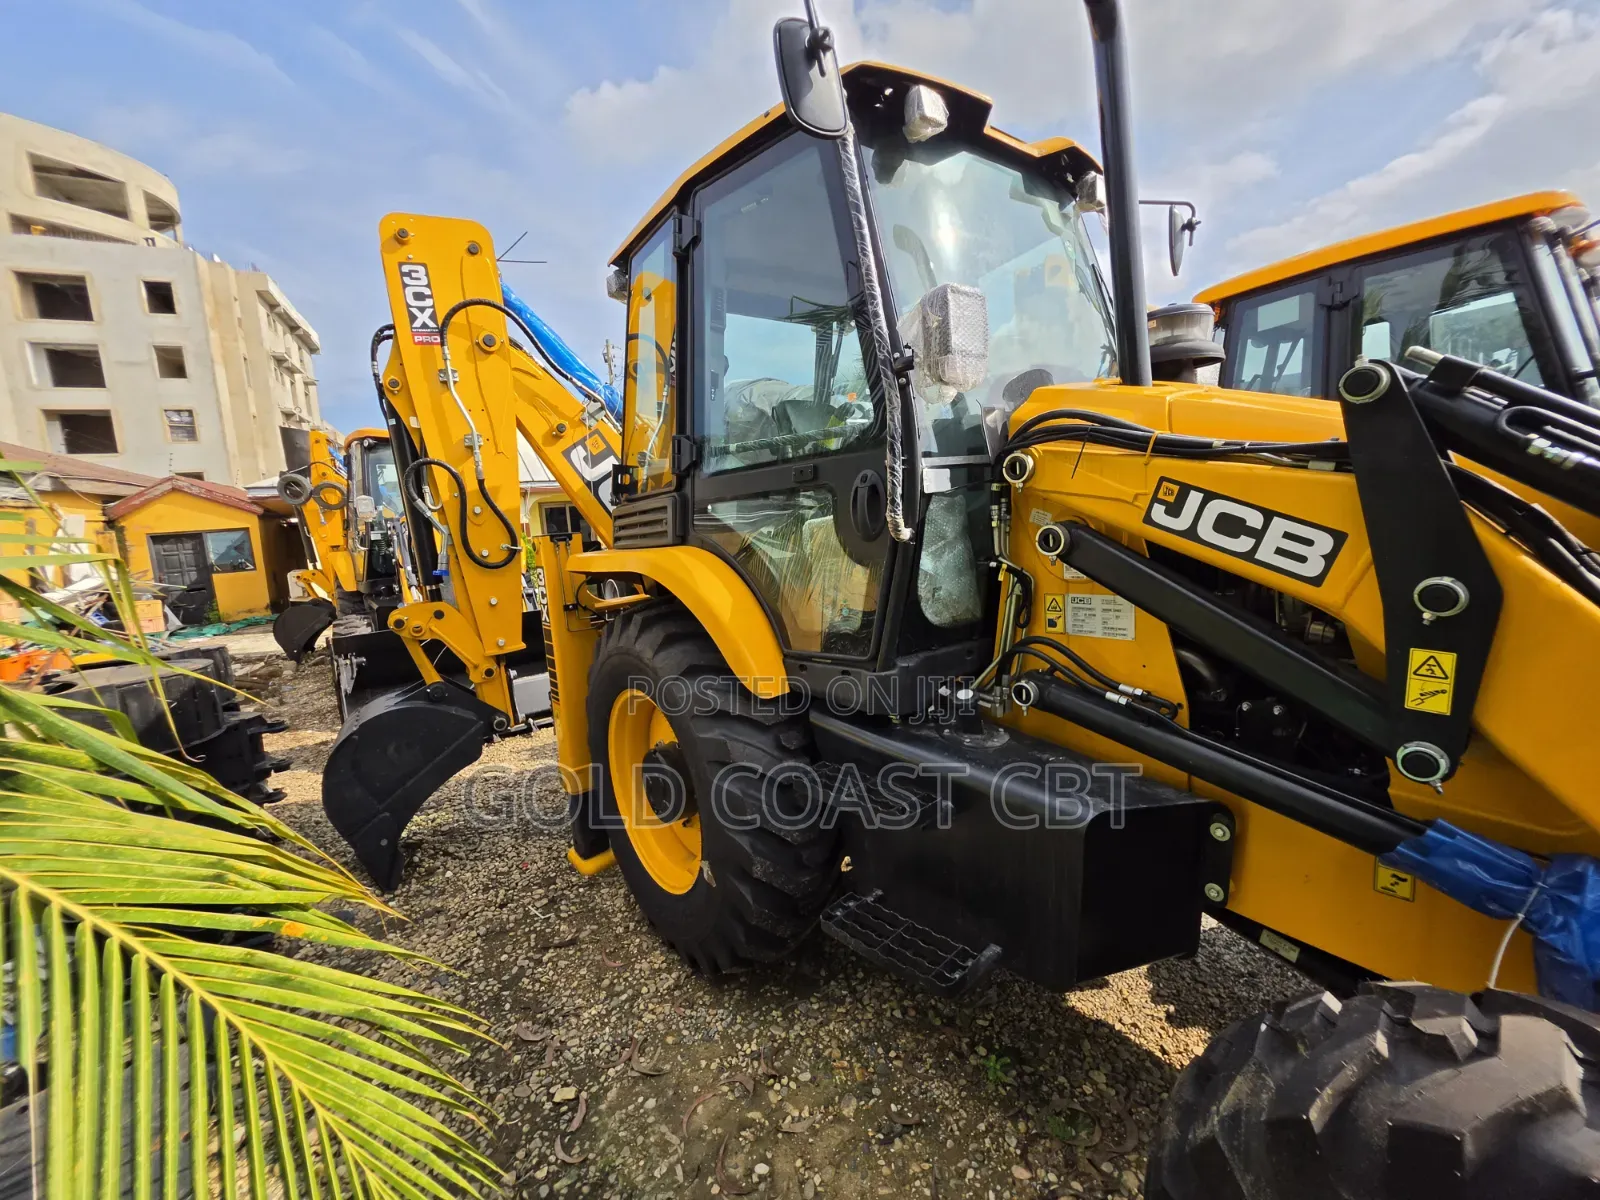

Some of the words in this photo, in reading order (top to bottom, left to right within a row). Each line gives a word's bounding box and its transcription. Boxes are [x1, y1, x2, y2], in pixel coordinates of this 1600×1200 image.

[401, 264, 438, 328] 3CX
[414, 335, 441, 343] PRO
[1151, 490, 1334, 577] JCB
[536, 567, 550, 622] 3CX
[1071, 597, 1091, 605] JCB
